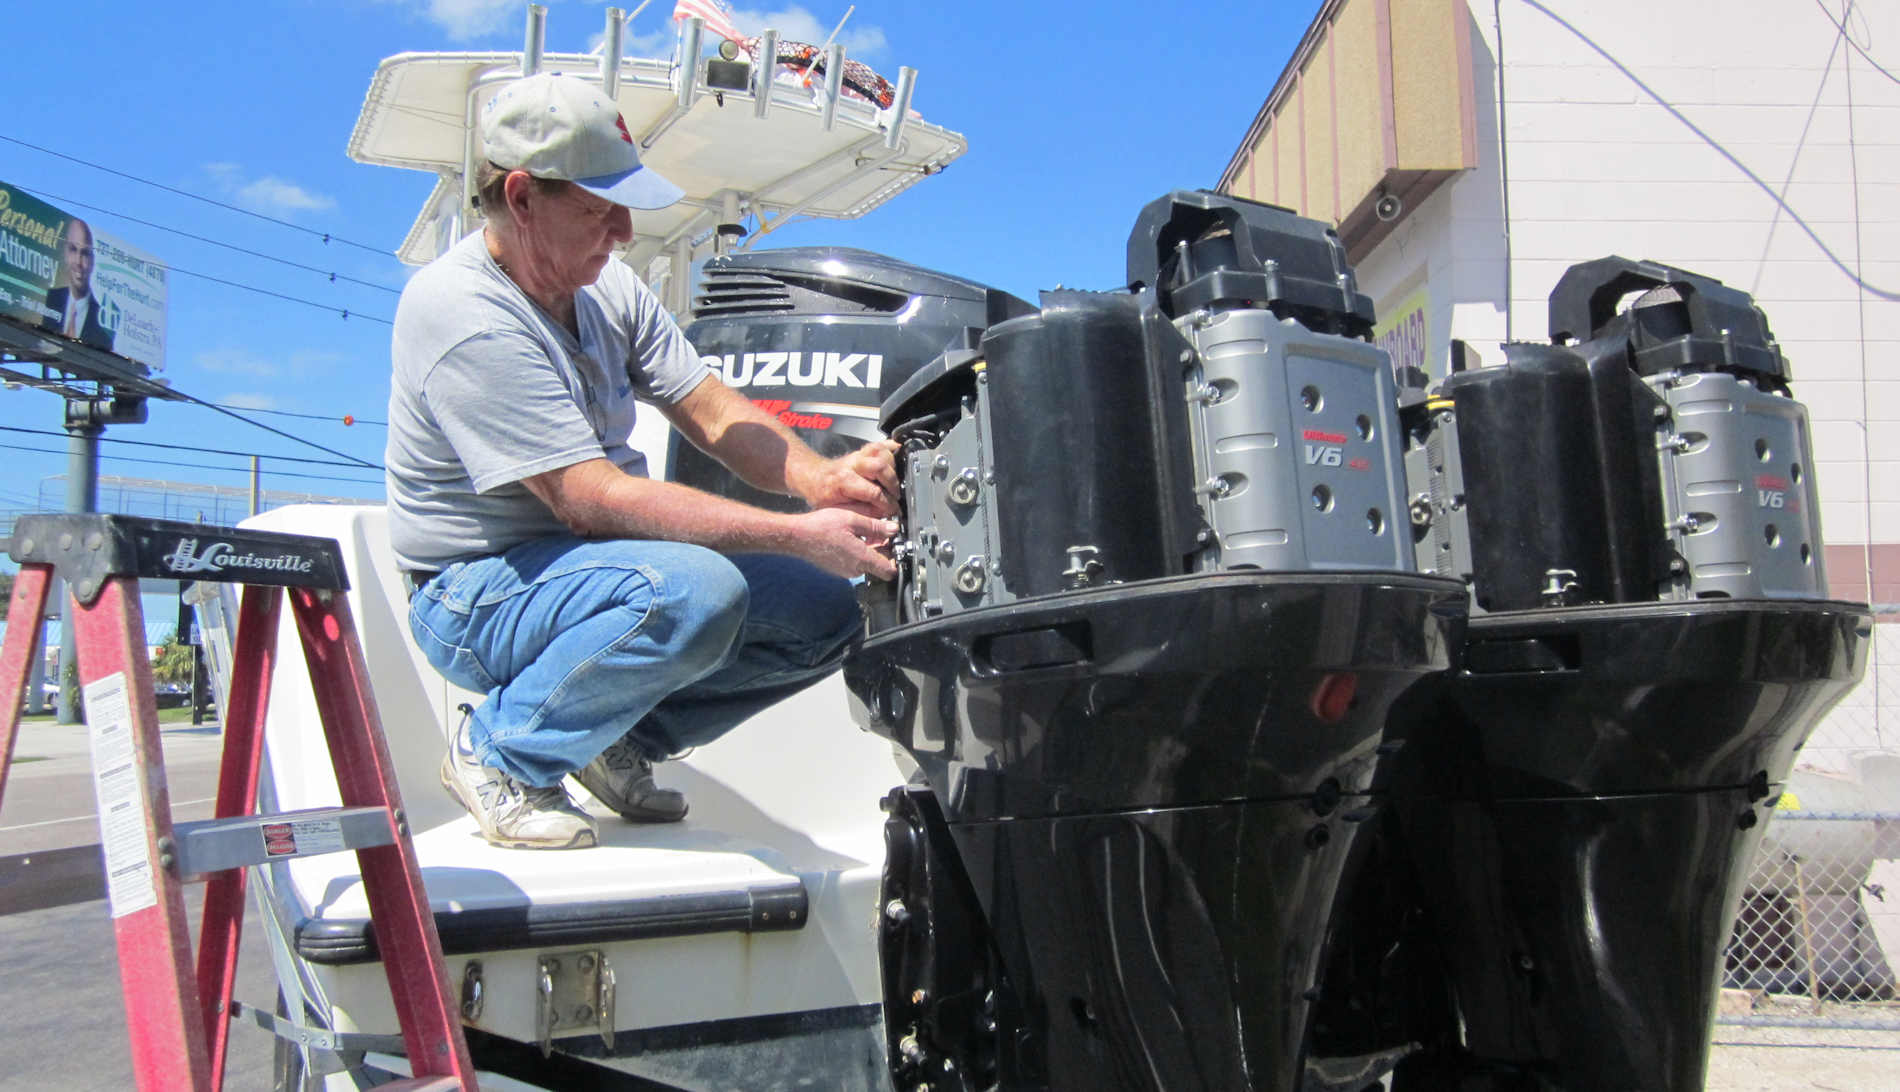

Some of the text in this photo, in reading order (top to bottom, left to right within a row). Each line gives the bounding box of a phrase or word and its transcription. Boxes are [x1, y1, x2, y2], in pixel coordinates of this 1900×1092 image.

[0, 231, 59, 288] Attorney
[700, 351, 883, 389] SUZUKI
[777, 411, 833, 430] Stroke
[1304, 445, 1343, 467] V6
[1759, 490, 1784, 508] V6
[194, 542, 313, 574] Louisville
